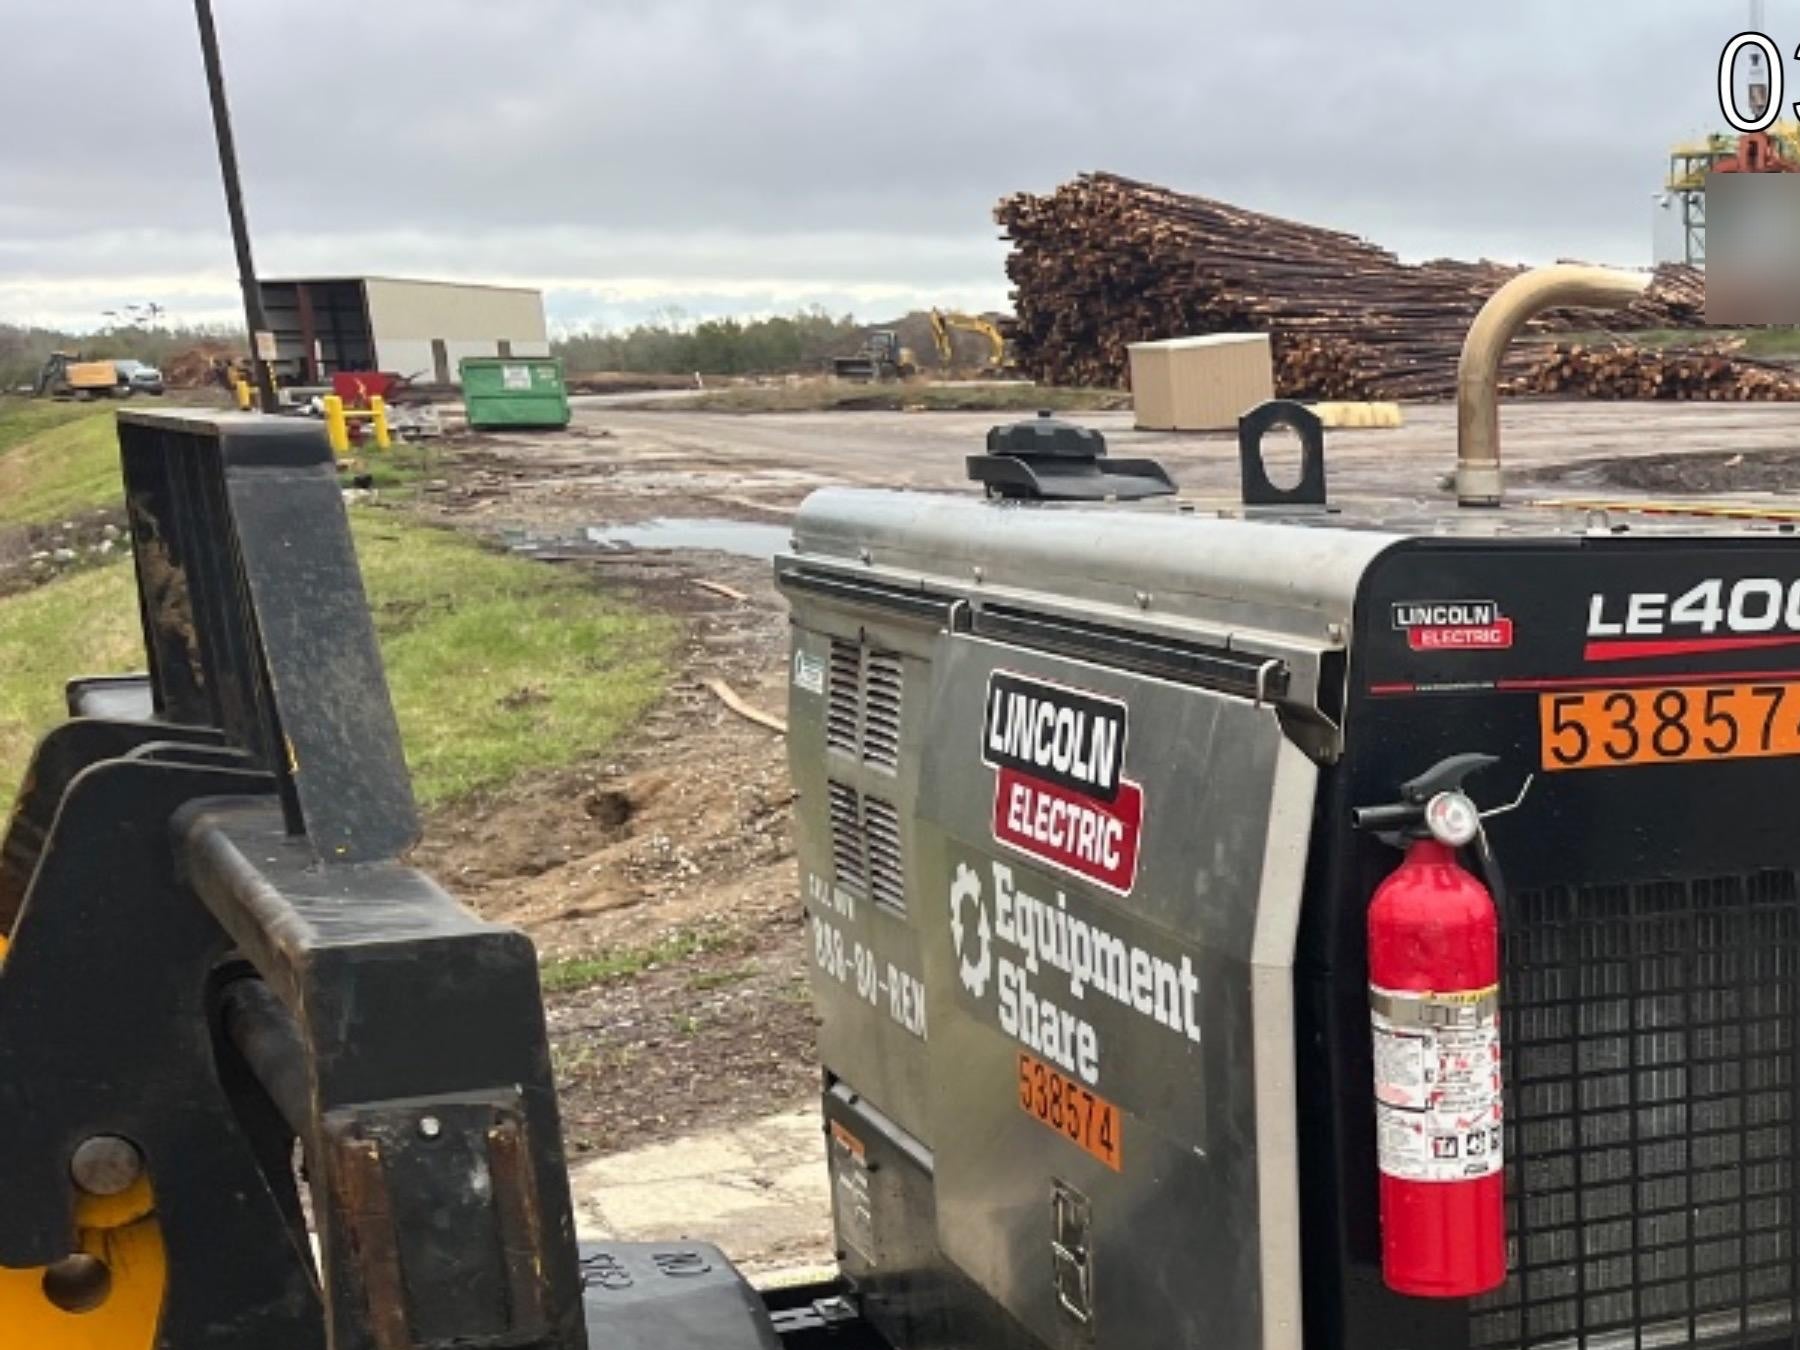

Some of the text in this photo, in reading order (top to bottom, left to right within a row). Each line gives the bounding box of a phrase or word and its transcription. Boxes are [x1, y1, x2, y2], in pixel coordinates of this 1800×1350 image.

[1397, 605, 1490, 625] LINCOLN
[1420, 629, 1502, 645] ELECTRIC
[989, 688, 1119, 788] LINCOLN
[1007, 782, 1124, 872] ELECTRIC
[992, 861, 1202, 1044] Equipment
[997, 963, 1100, 1085] Share
[1019, 1057, 1116, 1153] 538574
